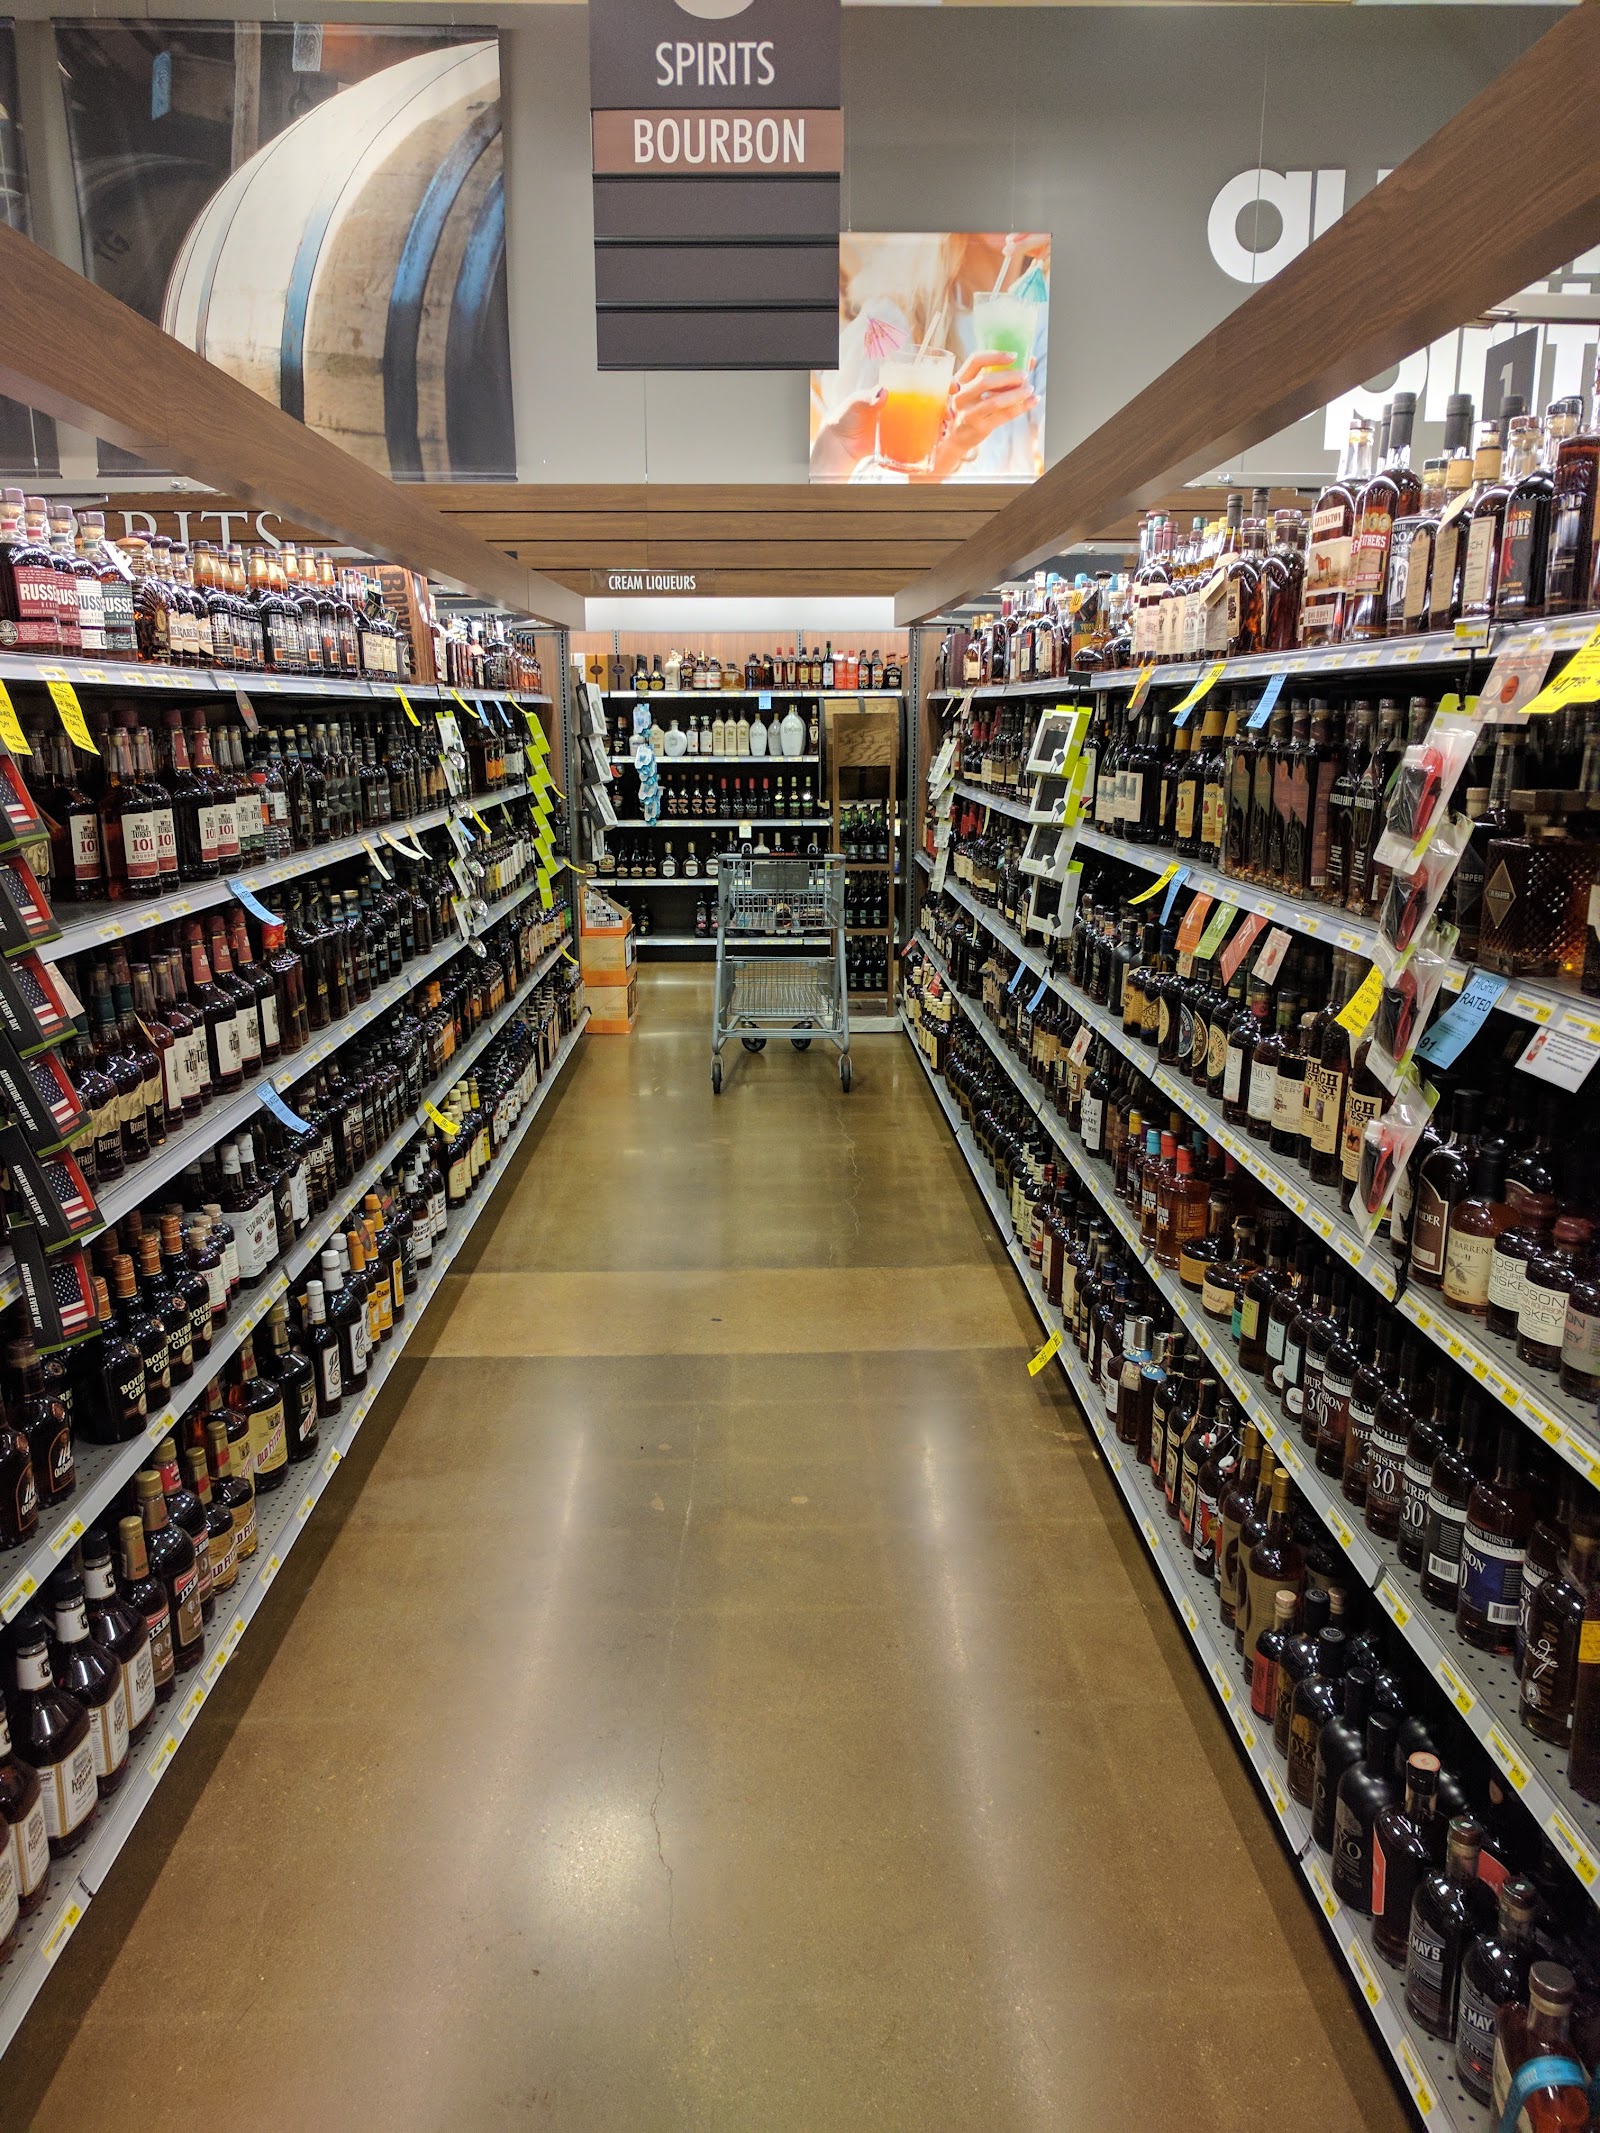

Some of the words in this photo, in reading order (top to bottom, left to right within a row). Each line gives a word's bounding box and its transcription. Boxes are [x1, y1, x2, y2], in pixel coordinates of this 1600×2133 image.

[655, 41, 775, 86] SPIRITS
[633, 118, 806, 164] BOURBON
[1314, 515, 1341, 527] LEXINGTON
[608, 574, 643, 591] CREAM
[646, 575, 697, 592] LIQUEURS
[219, 825, 234, 835] 101
[132, 839, 154, 852] 101
[1473, 977, 1502, 996] HIGHLY
[1460, 992, 1492, 1012] RATED
[1419, 1036, 1436, 1052] 91
[0, 1069, 22, 1104] ADVENTURE
[18, 1101, 33, 1122] EVERY
[12, 1165, 32, 1202] ADVENTURE
[28, 1197, 42, 1216] EVERY
[21, 1263, 34, 1299] ADVENTURE
[29, 1296, 40, 1317] EVERY
[1546, 1424, 1562, 1440] $50.99
[257, 1450, 269, 1467] OLD
[1372, 1464, 1395, 1494] 30
[1402, 1495, 1424, 1527] 30
[1483, 1532, 1514, 1548] WHISKEY
[1412, 1934, 1440, 1961] MAY'S
